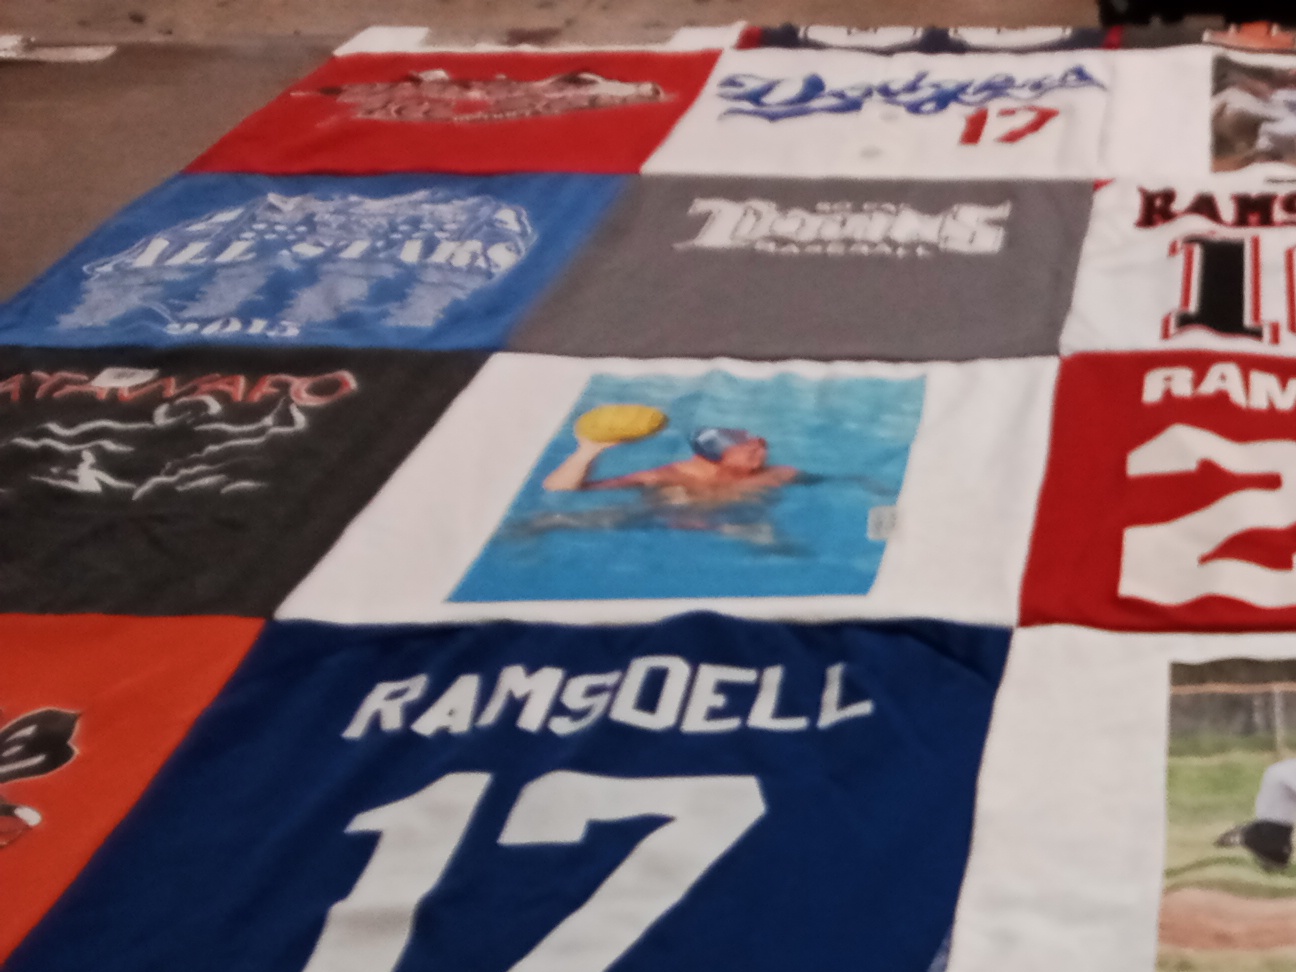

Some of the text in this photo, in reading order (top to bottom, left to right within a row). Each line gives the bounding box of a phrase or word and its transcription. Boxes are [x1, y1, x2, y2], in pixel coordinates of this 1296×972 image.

[715, 63, 1106, 122] Dodgers
[959, 105, 1060, 145] 17
[341, 654, 875, 740] RAMSDELL
